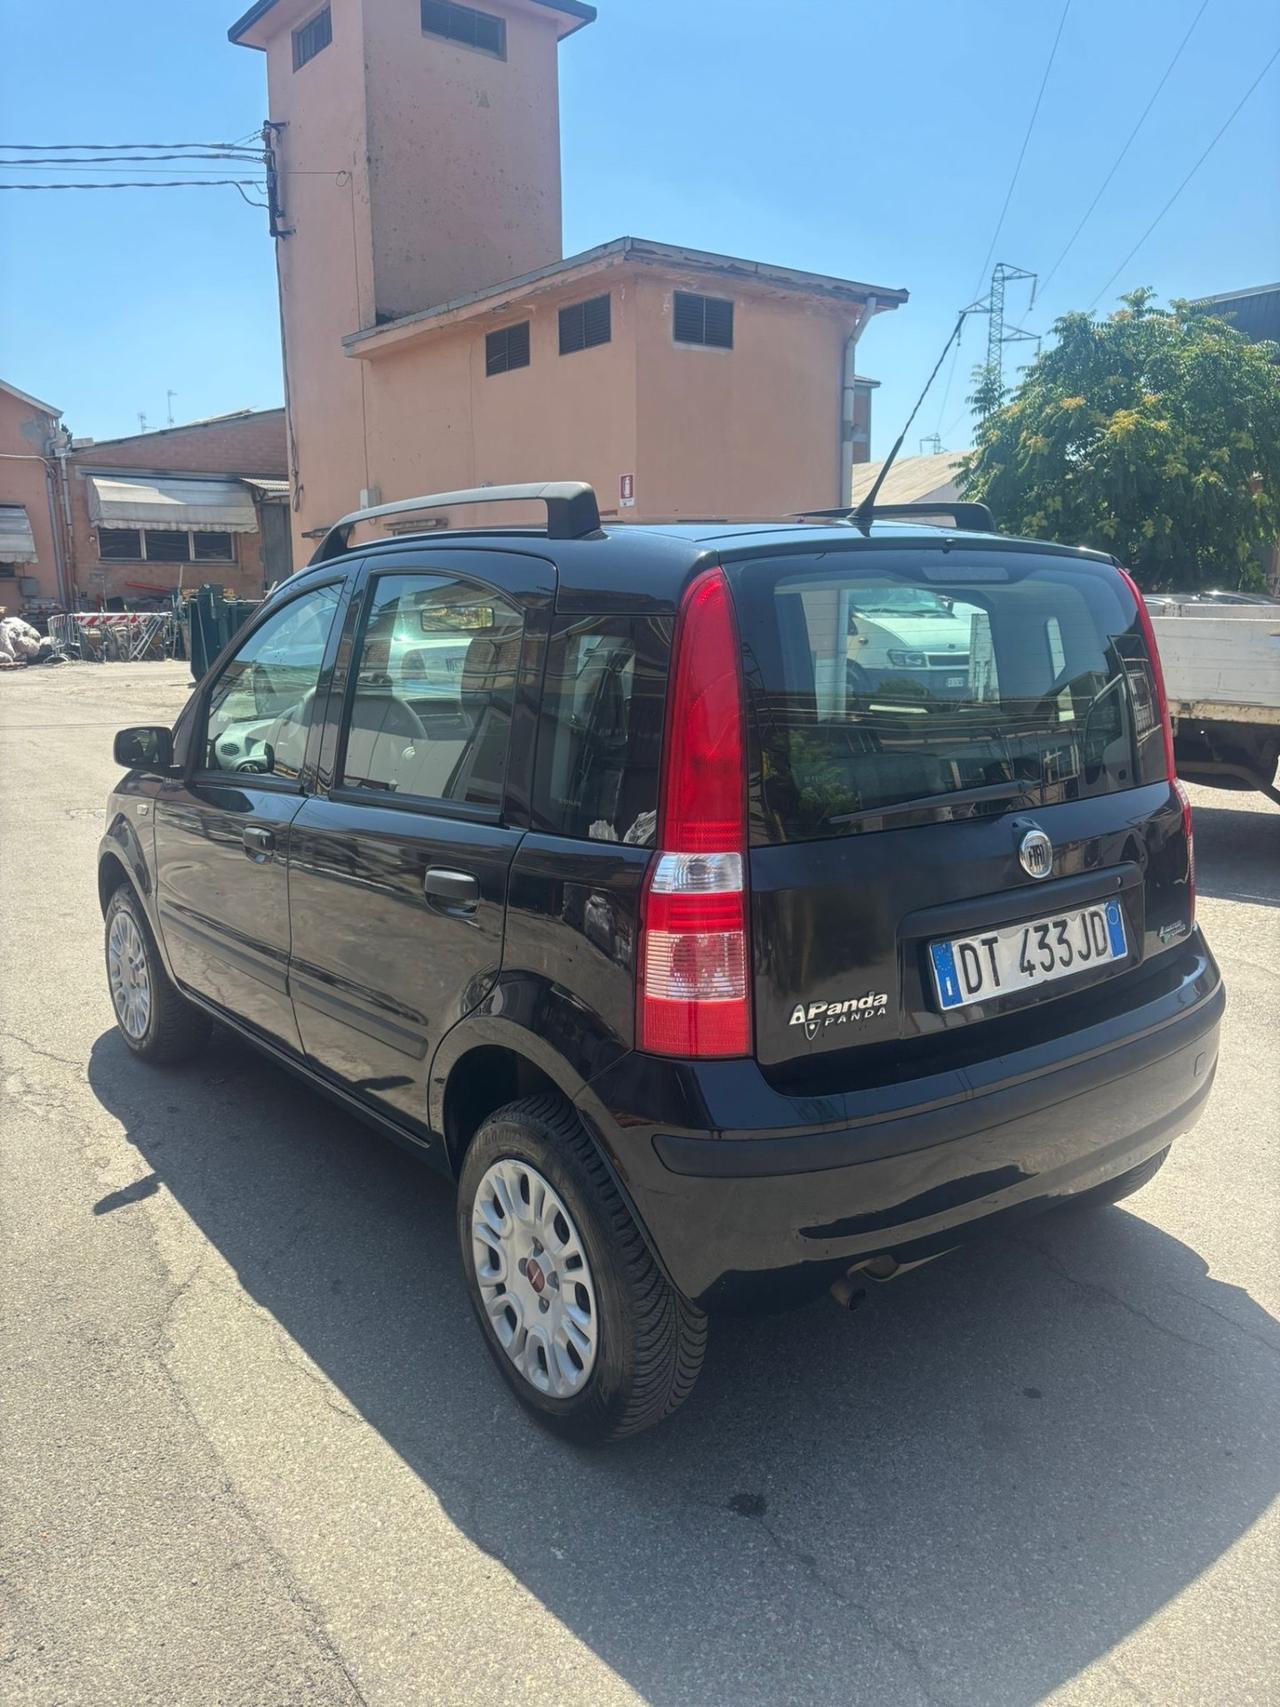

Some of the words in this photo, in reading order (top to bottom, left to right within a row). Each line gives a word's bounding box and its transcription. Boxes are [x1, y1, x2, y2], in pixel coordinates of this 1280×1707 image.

[959, 938, 1001, 995] DT
[1019, 918, 1073, 978] 433
[1078, 910, 1109, 962] JD
[824, 1007, 886, 1027] PANDA
